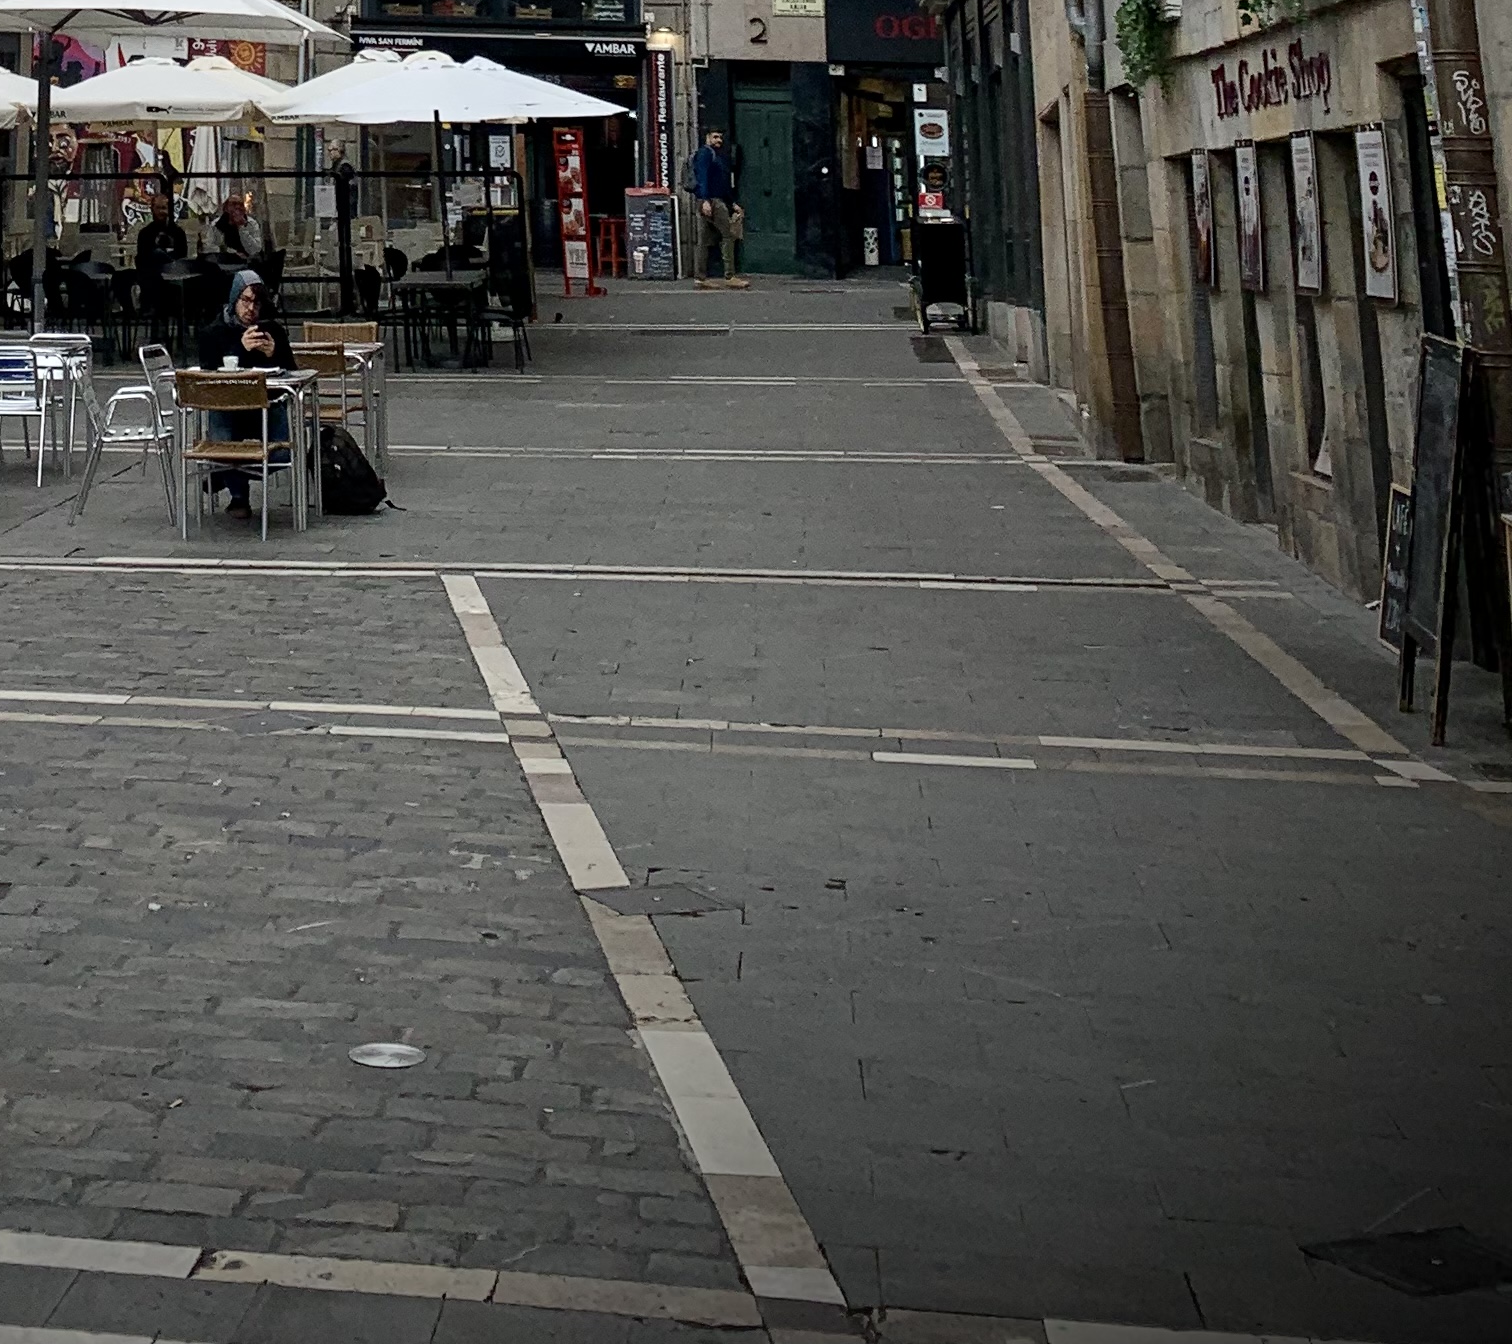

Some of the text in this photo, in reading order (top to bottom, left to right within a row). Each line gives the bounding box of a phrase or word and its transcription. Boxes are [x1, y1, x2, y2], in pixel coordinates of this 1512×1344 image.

[378, 36, 394, 45] SAN
[594, 43, 636, 55] AMBAR
[749, 17, 768, 44] 2
[657, 53, 667, 123] Restaurante
[1210, 37, 1331, 120] The Cookie Shop
[659, 132, 669, 188] ervecería
